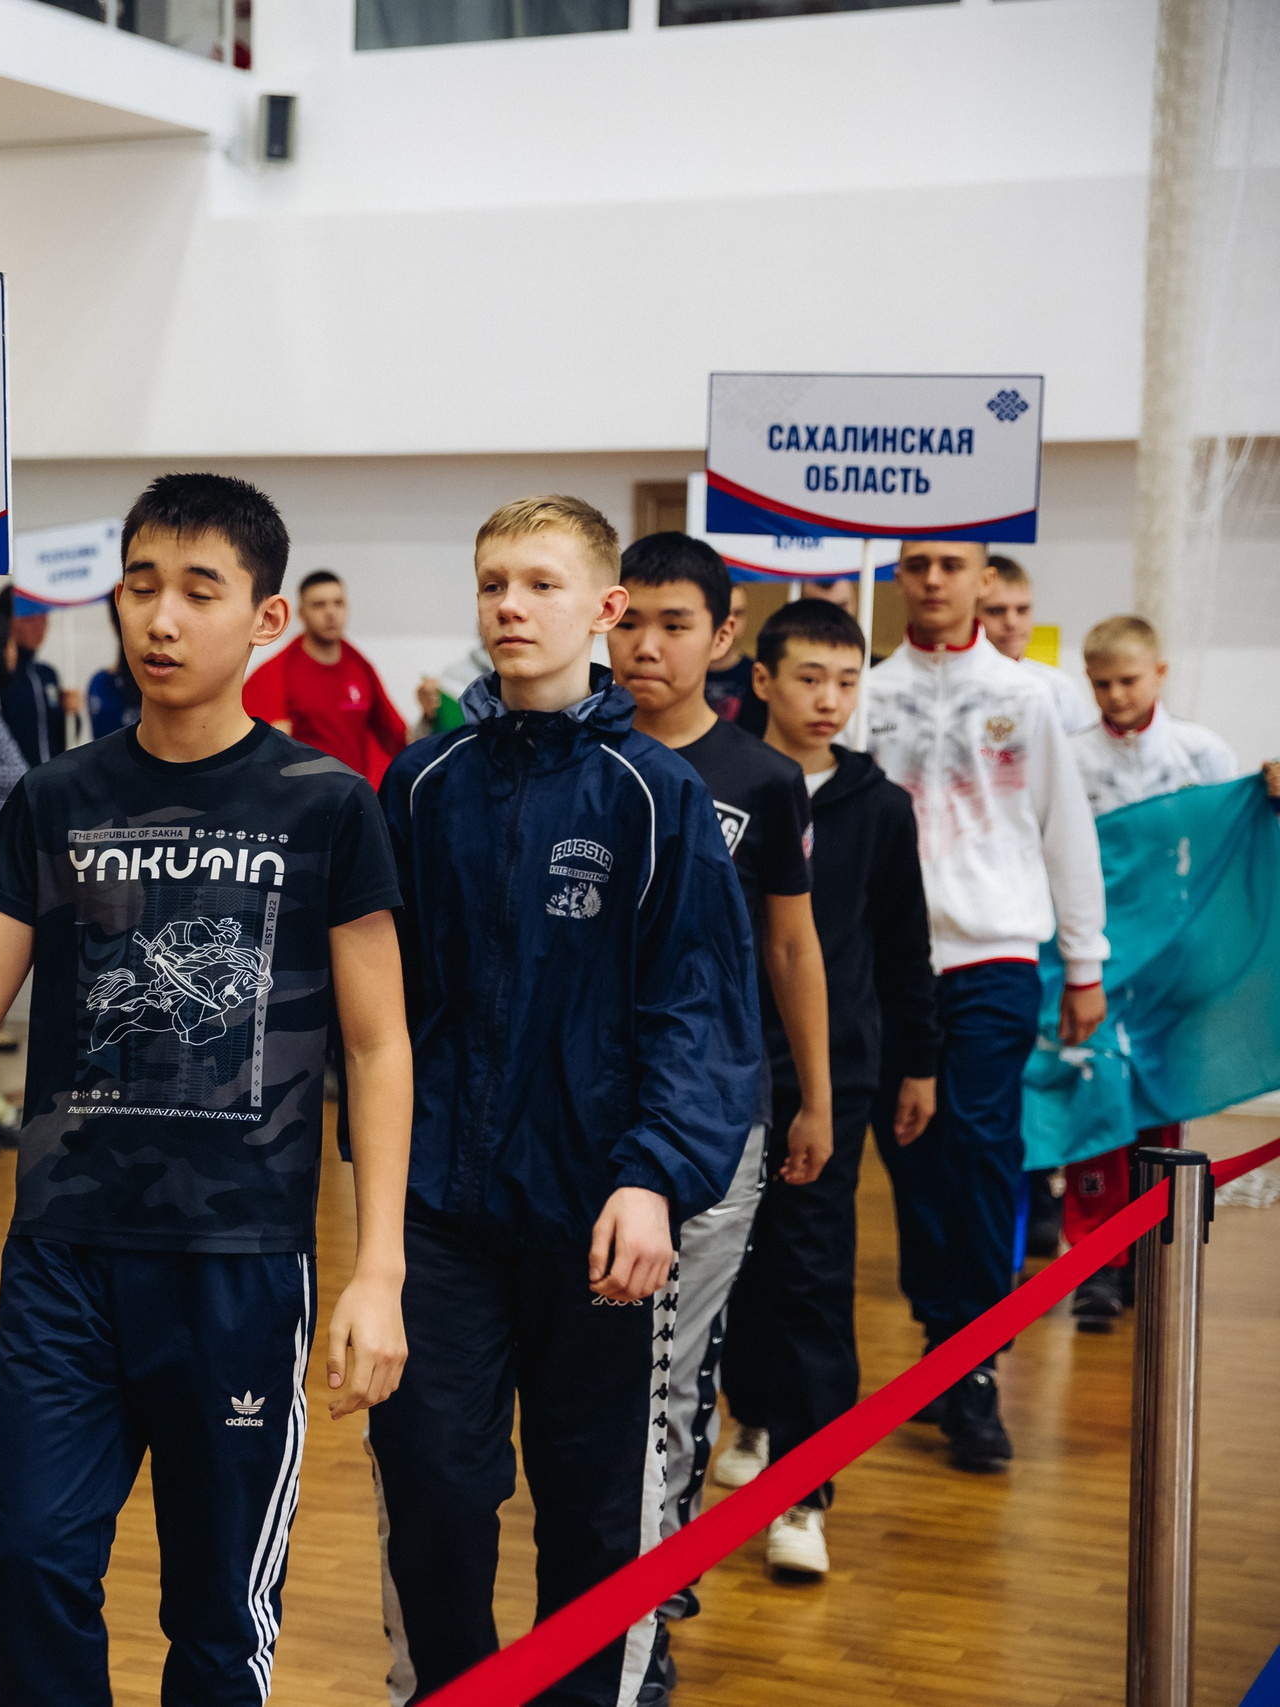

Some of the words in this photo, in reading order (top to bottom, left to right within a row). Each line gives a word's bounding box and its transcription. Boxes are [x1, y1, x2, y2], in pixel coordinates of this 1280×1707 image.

[768, 424, 975, 455] САХАЛИНСКАЯ
[805, 464, 931, 495] ОБЛАСТЬ
[72, 832, 91, 841] THE
[93, 830, 136, 840] REPUBLIC
[138, 829, 151, 838] OF
[151, 829, 184, 838] SAKHA
[69, 846, 285, 886] YAKUTIA
[550, 838, 614, 873] RUSSIA
[267, 900, 277, 922] 1922
[264, 925, 274, 946] EST.
[225, 1416, 264, 1427] adidas
